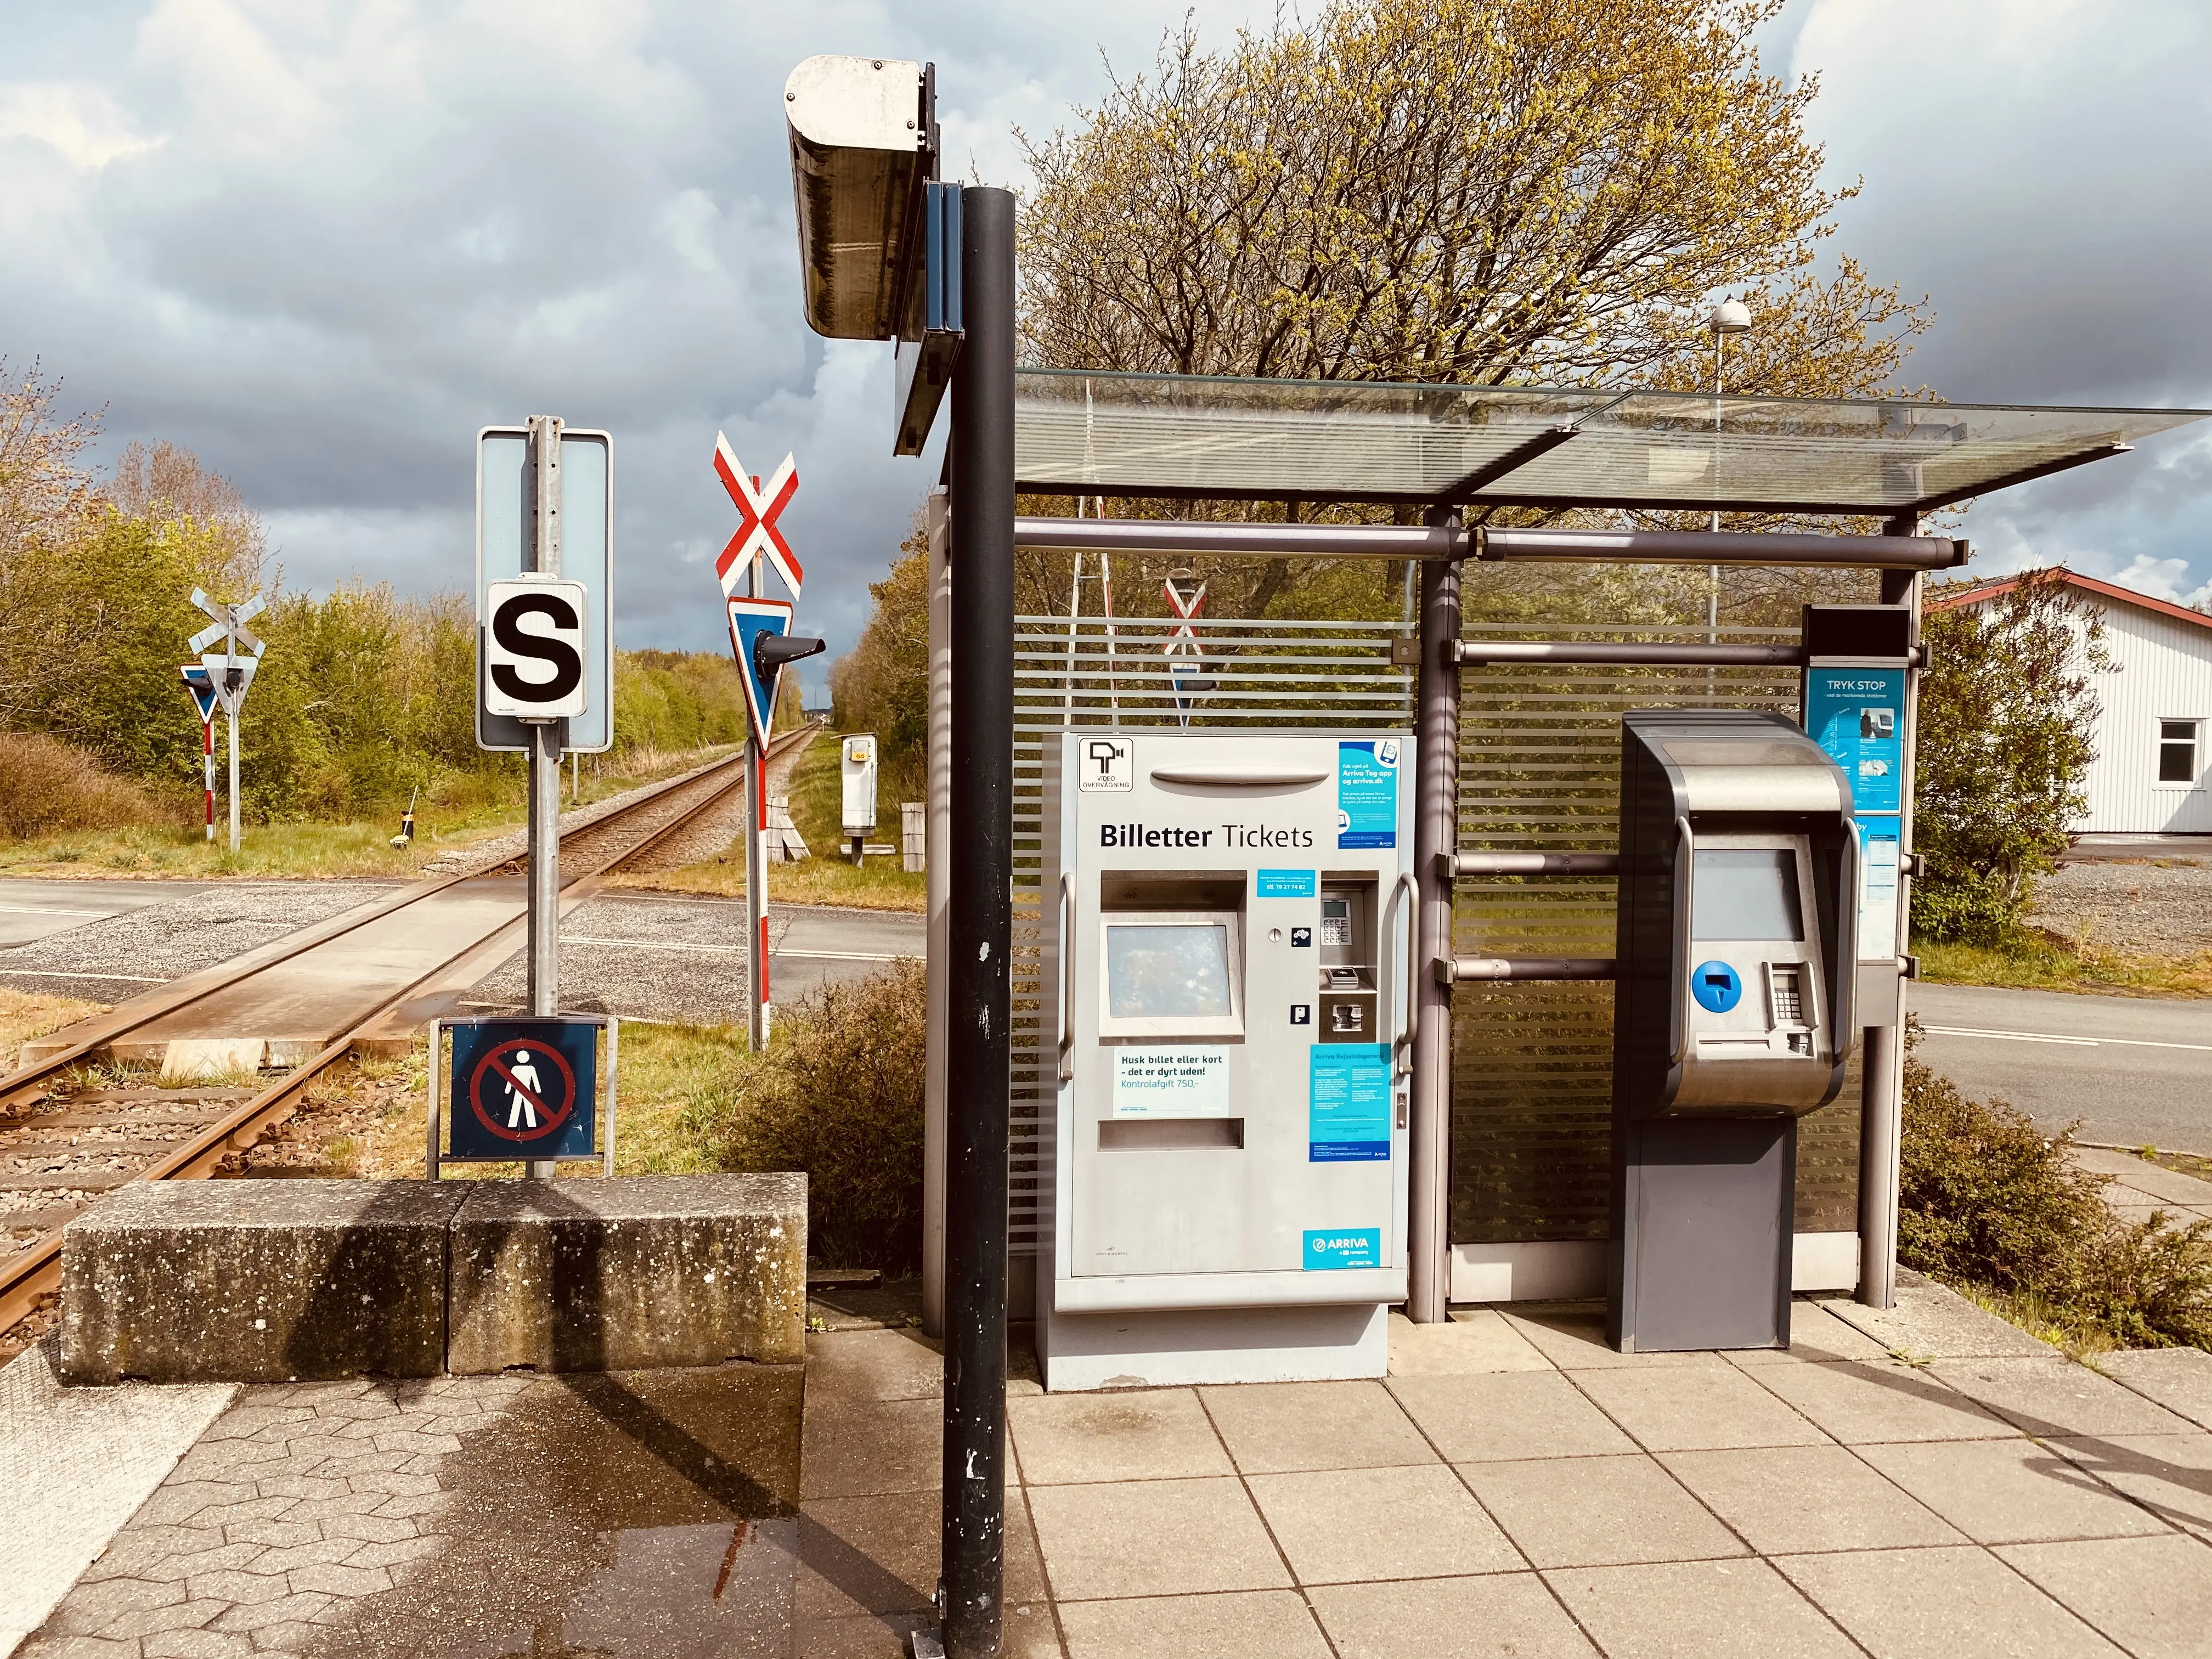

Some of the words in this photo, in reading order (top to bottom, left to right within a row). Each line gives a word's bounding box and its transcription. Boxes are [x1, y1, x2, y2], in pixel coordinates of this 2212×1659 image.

[491, 593, 582, 702] S
[1827, 680, 1855, 690] TRYK
[1857, 680, 1886, 690] STOP
[1101, 824, 1213, 847] Billetter
[1222, 824, 1313, 847] Tickets
[1148, 1056, 1173, 1064] billet
[1202, 1055, 1222, 1063] kort
[1158, 1068, 1177, 1077] dyrt
[1180, 1067, 1205, 1075] uden!
[1121, 1079, 1175, 1090] Kontrolafgift
[1177, 1079, 1199, 1088] 750,-
[1327, 1238, 1369, 1249] ARRIVA
